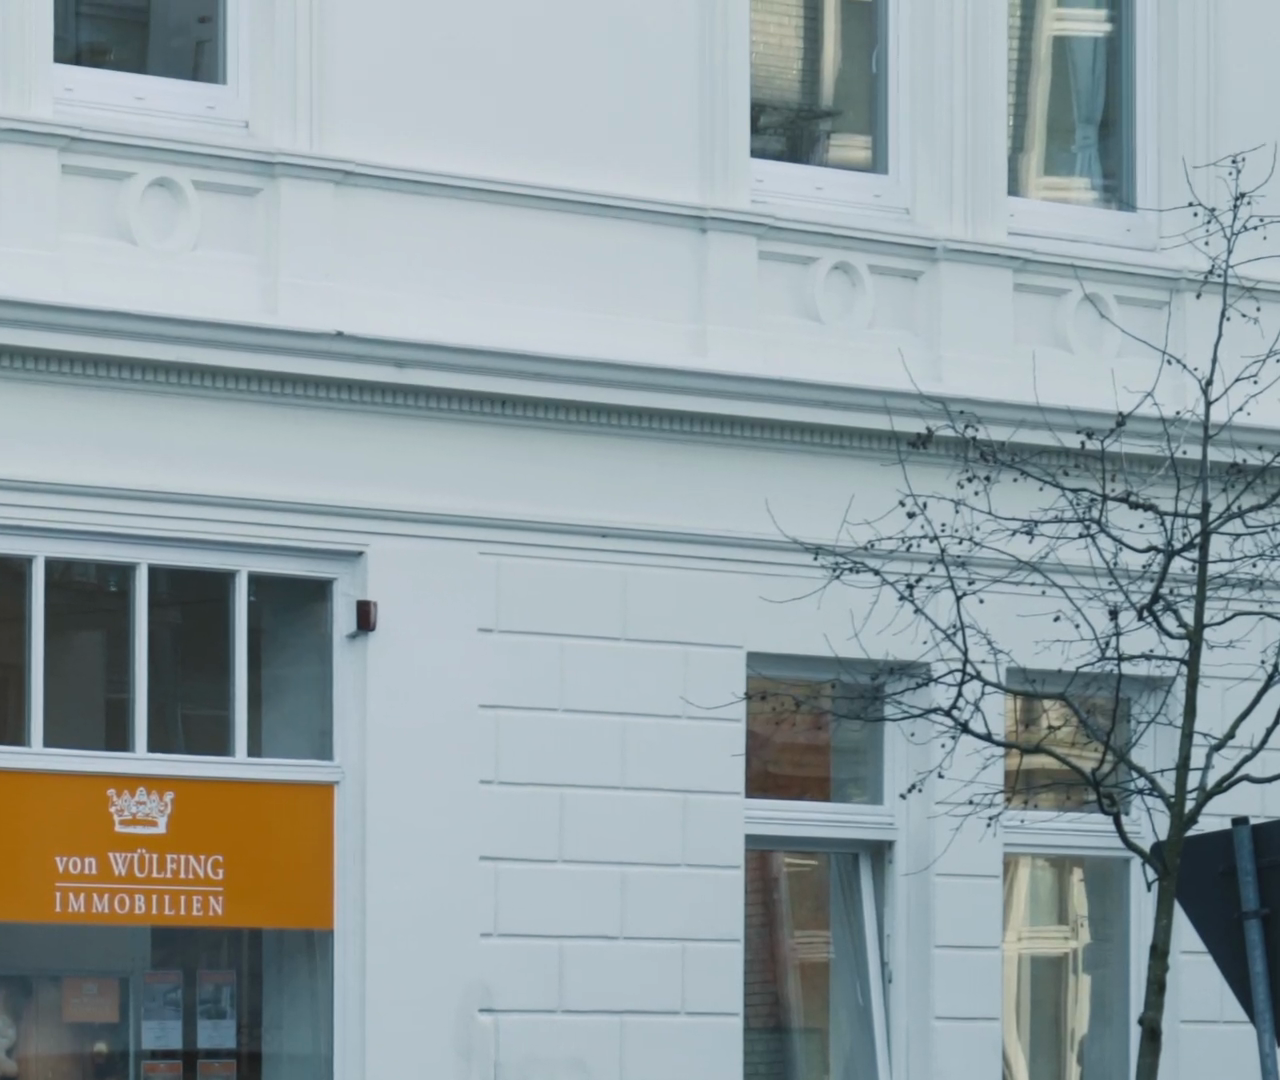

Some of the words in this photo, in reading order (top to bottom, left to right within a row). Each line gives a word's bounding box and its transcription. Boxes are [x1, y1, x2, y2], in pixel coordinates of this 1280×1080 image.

[54, 856, 97, 874] von
[108, 848, 224, 880] WÜLFING
[54, 891, 223, 916] IMMOBILIEN
